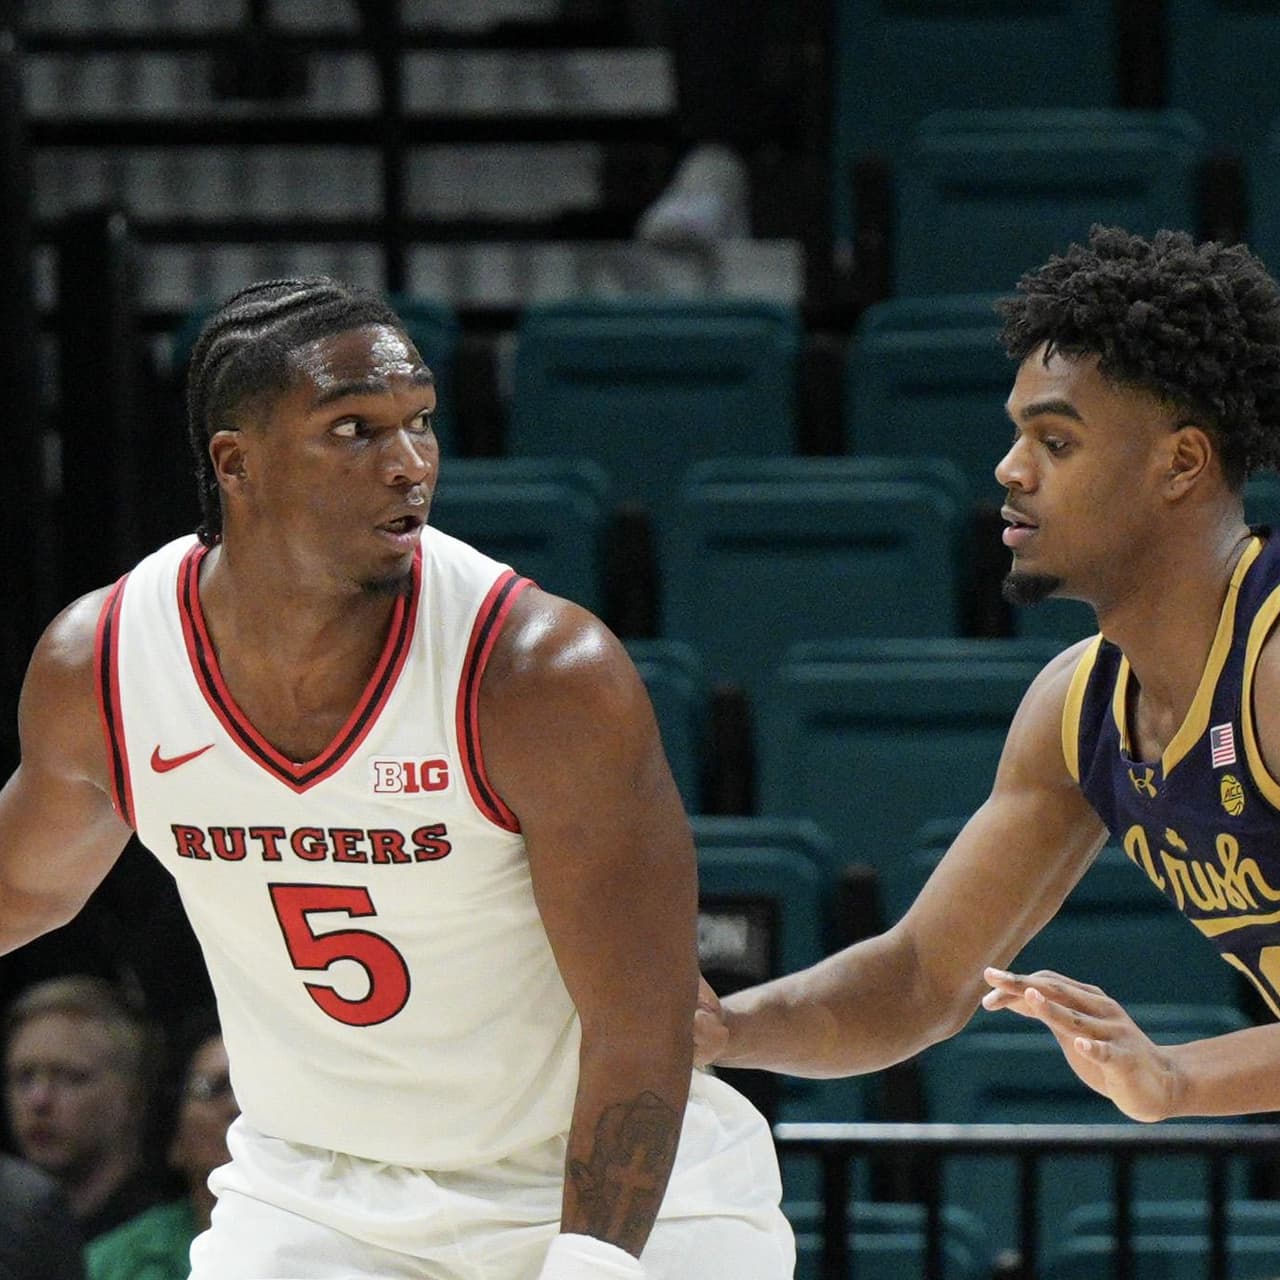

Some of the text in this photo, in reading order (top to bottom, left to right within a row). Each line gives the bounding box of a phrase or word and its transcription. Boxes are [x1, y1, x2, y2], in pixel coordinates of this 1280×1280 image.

[1223, 784, 1243, 801] ACC
[170, 823, 452, 864] RUTGERS
[267, 882, 412, 1027] 5
